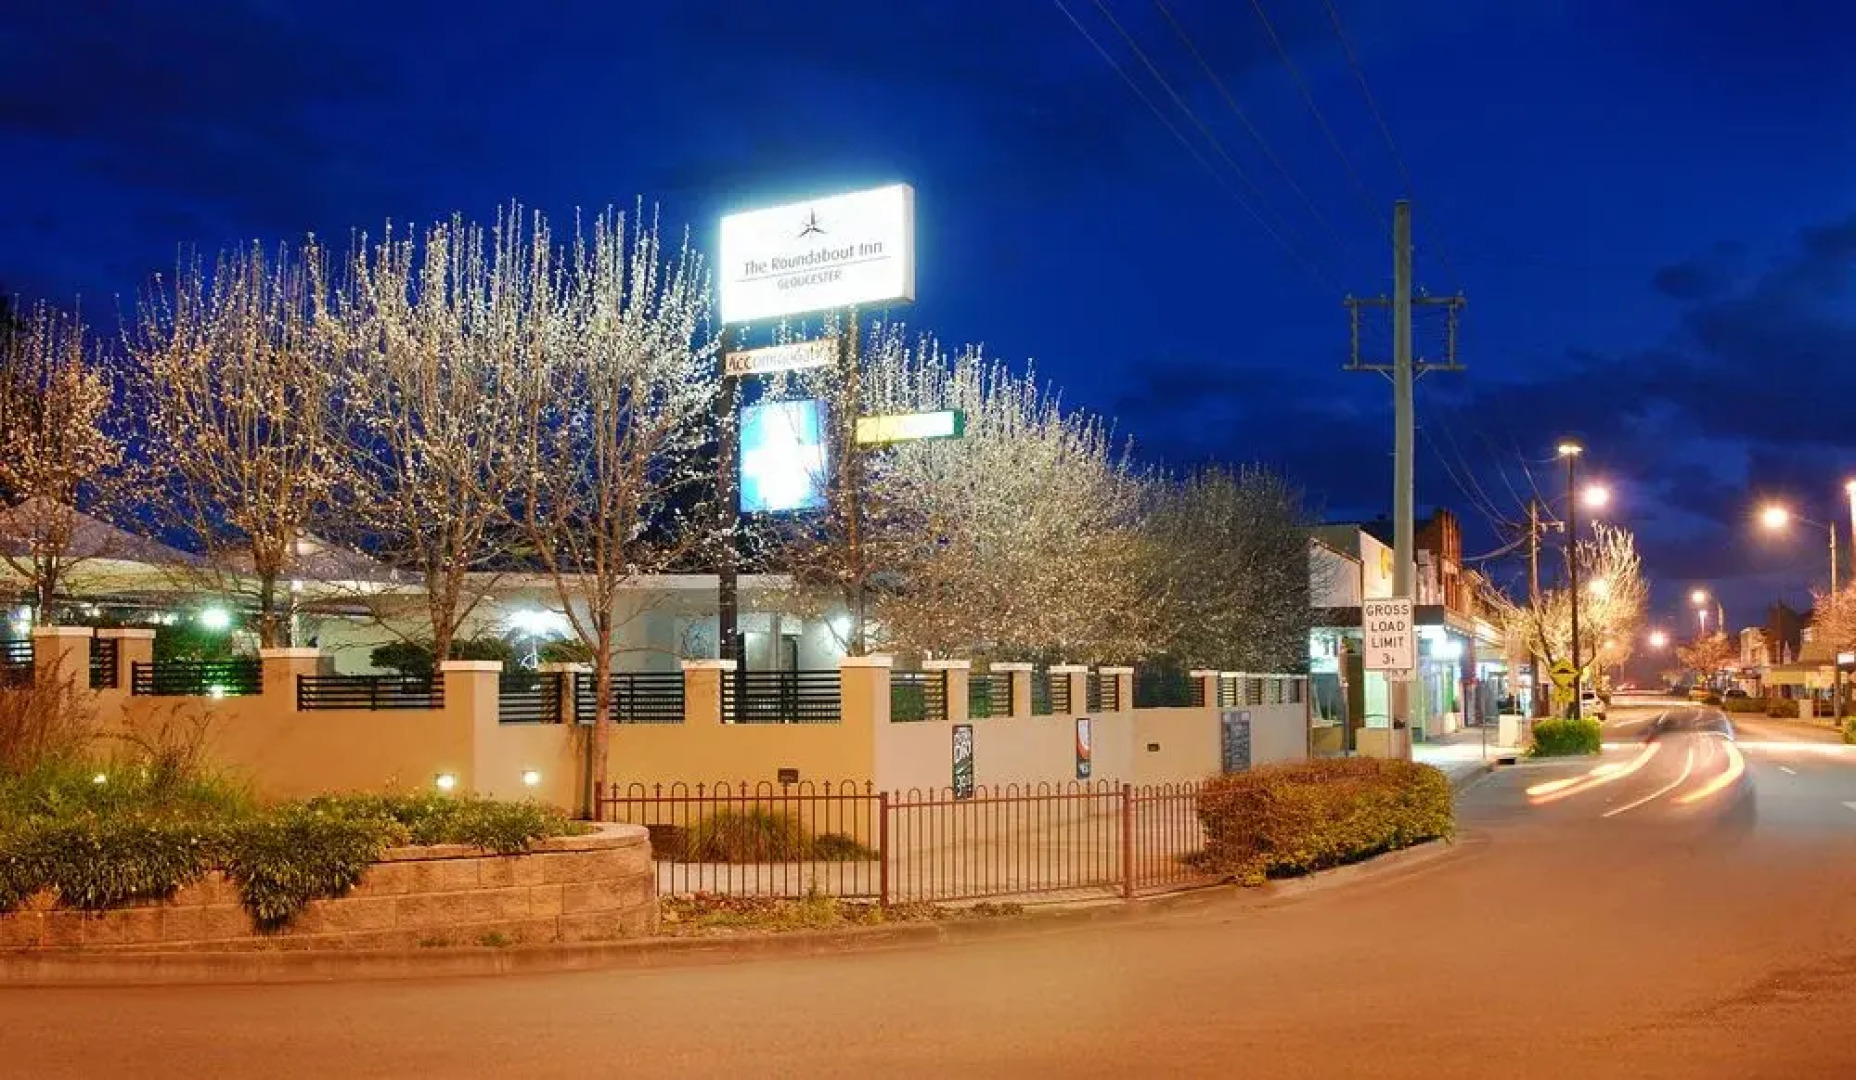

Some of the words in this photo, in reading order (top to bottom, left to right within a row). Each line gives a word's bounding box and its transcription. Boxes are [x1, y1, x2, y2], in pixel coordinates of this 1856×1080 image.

[744, 260, 767, 275] The
[771, 245, 855, 271] Roundabout
[858, 242, 883, 257] Inn
[777, 270, 842, 290] GLOUCESTER
[1366, 604, 1409, 616] GROSS
[1371, 621, 1405, 632] LOAD
[1371, 636, 1404, 648] LIMIT
